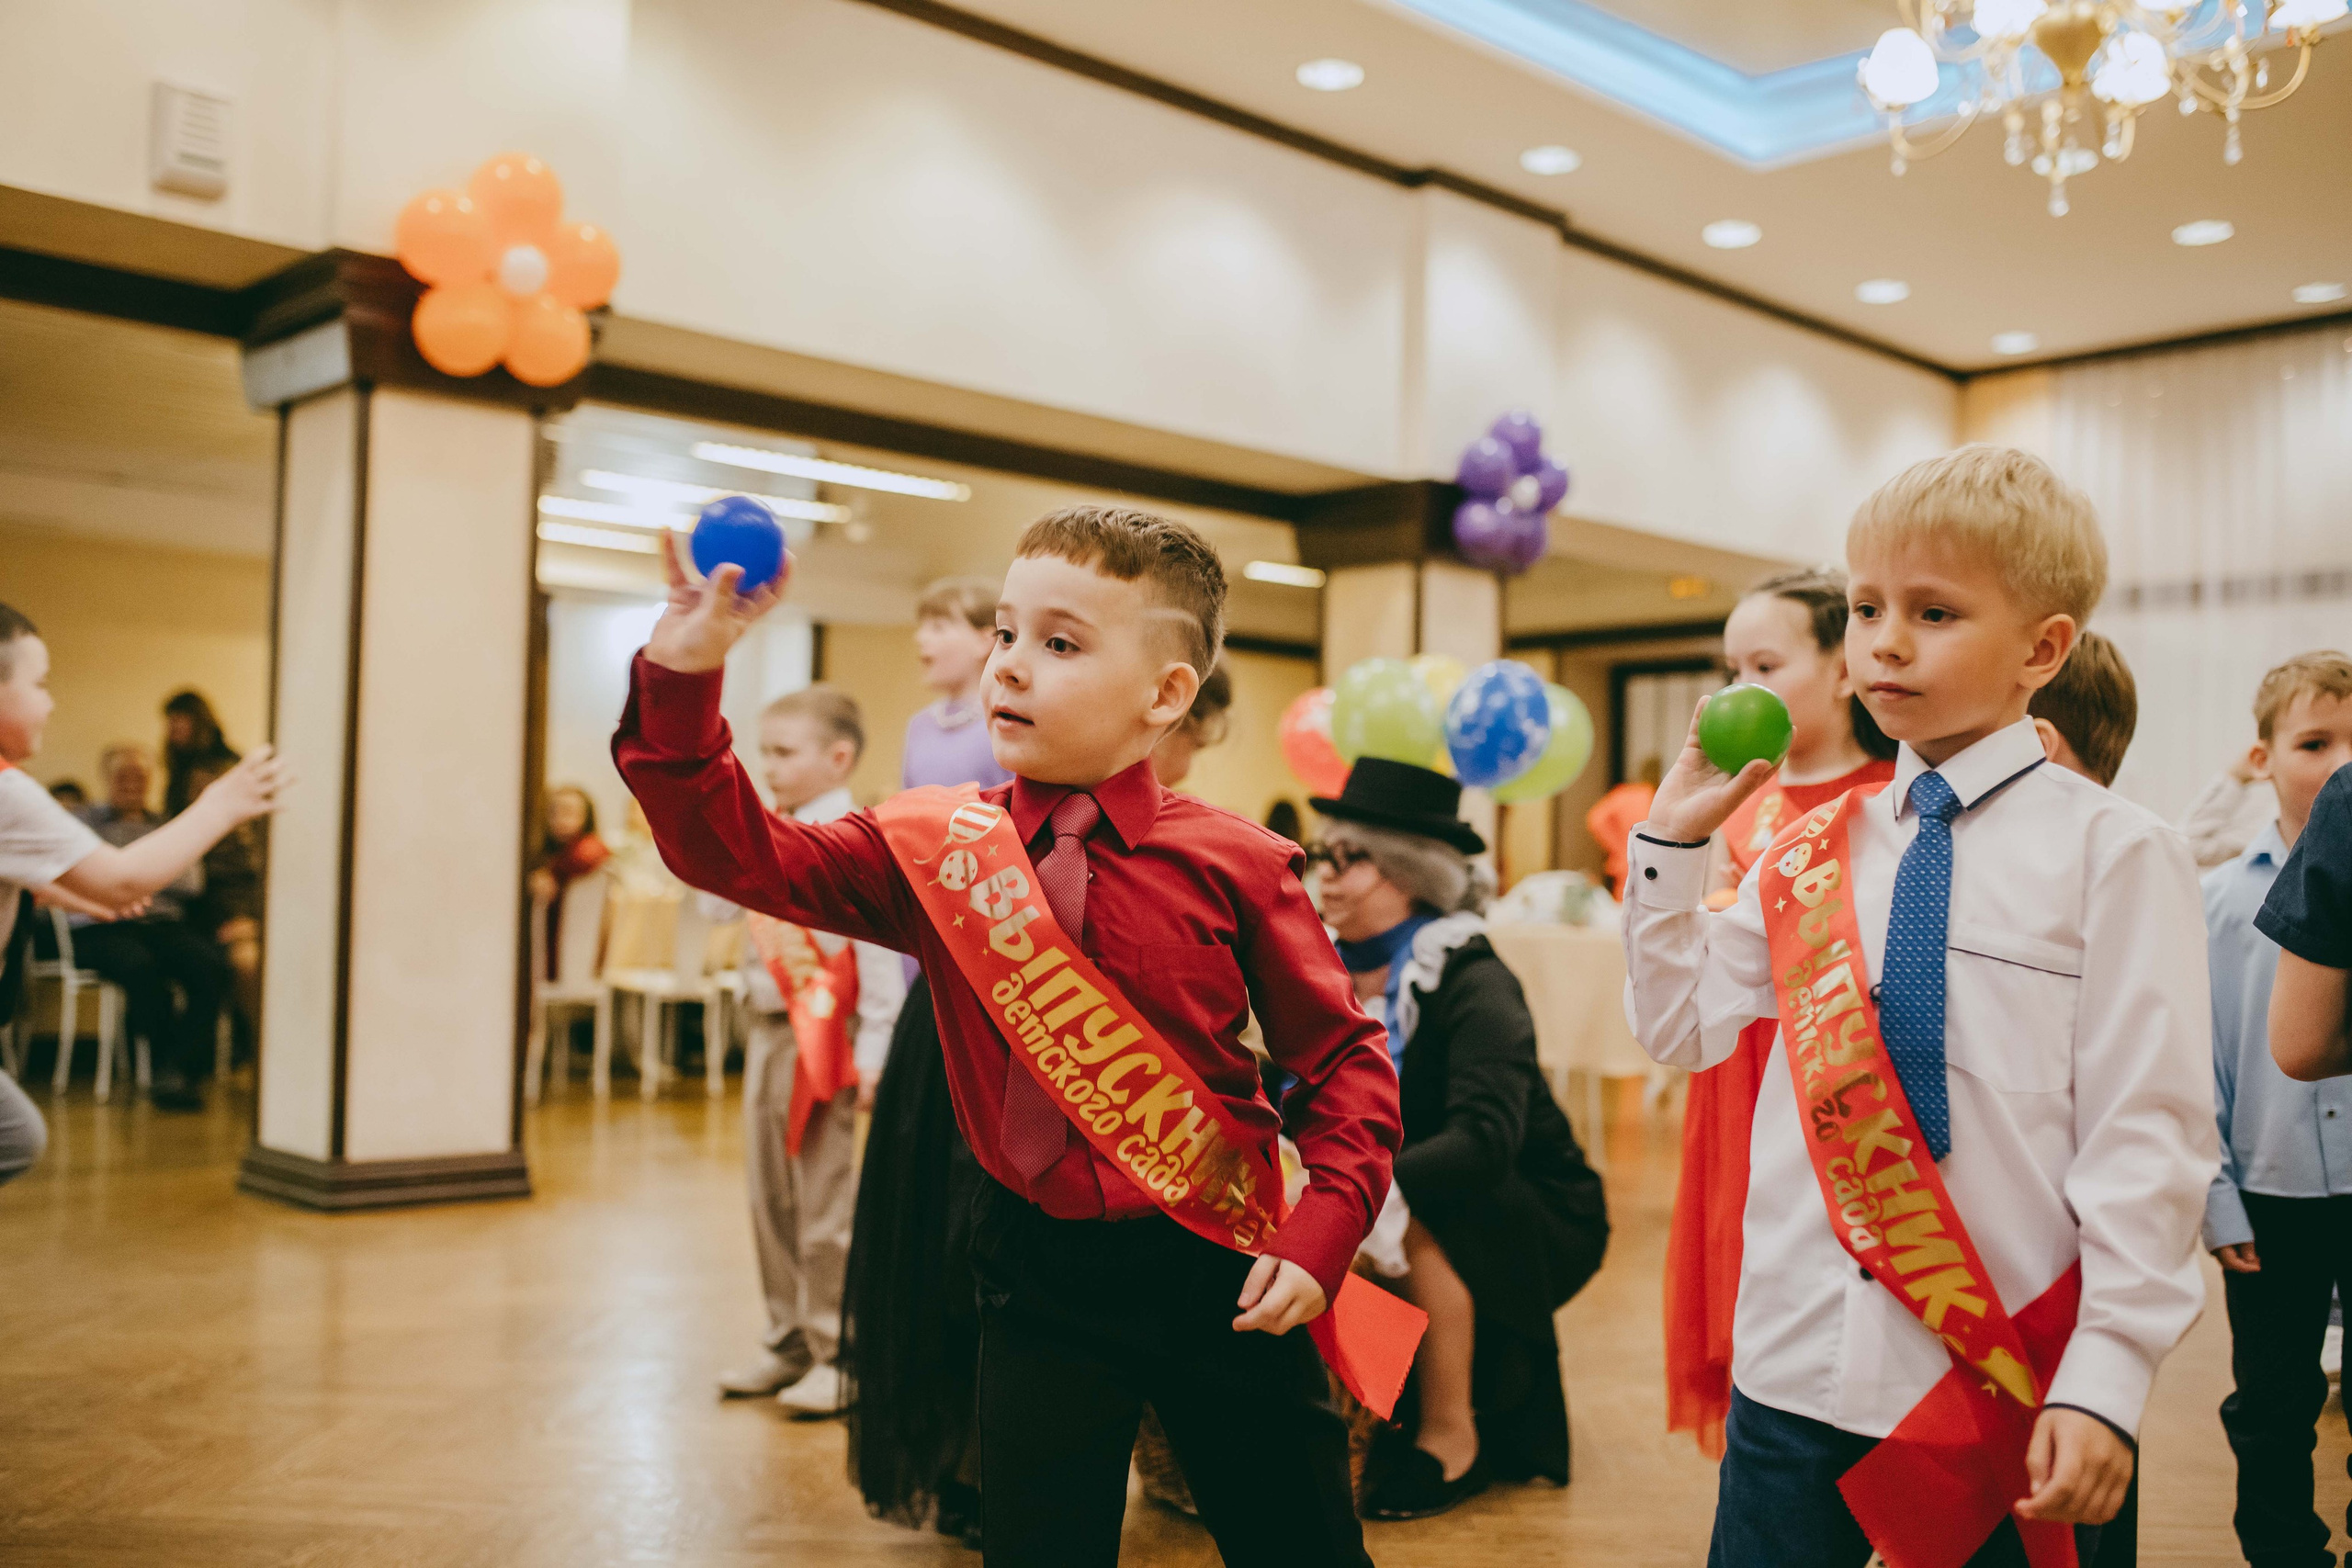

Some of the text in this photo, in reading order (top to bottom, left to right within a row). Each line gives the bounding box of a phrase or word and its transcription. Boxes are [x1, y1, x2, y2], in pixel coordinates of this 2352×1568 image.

[991, 972, 1190, 1207] детского сада
[1783, 959, 1883, 1254] детского сада
[1792, 857, 1987, 1332] ВЫПУСКНИК
